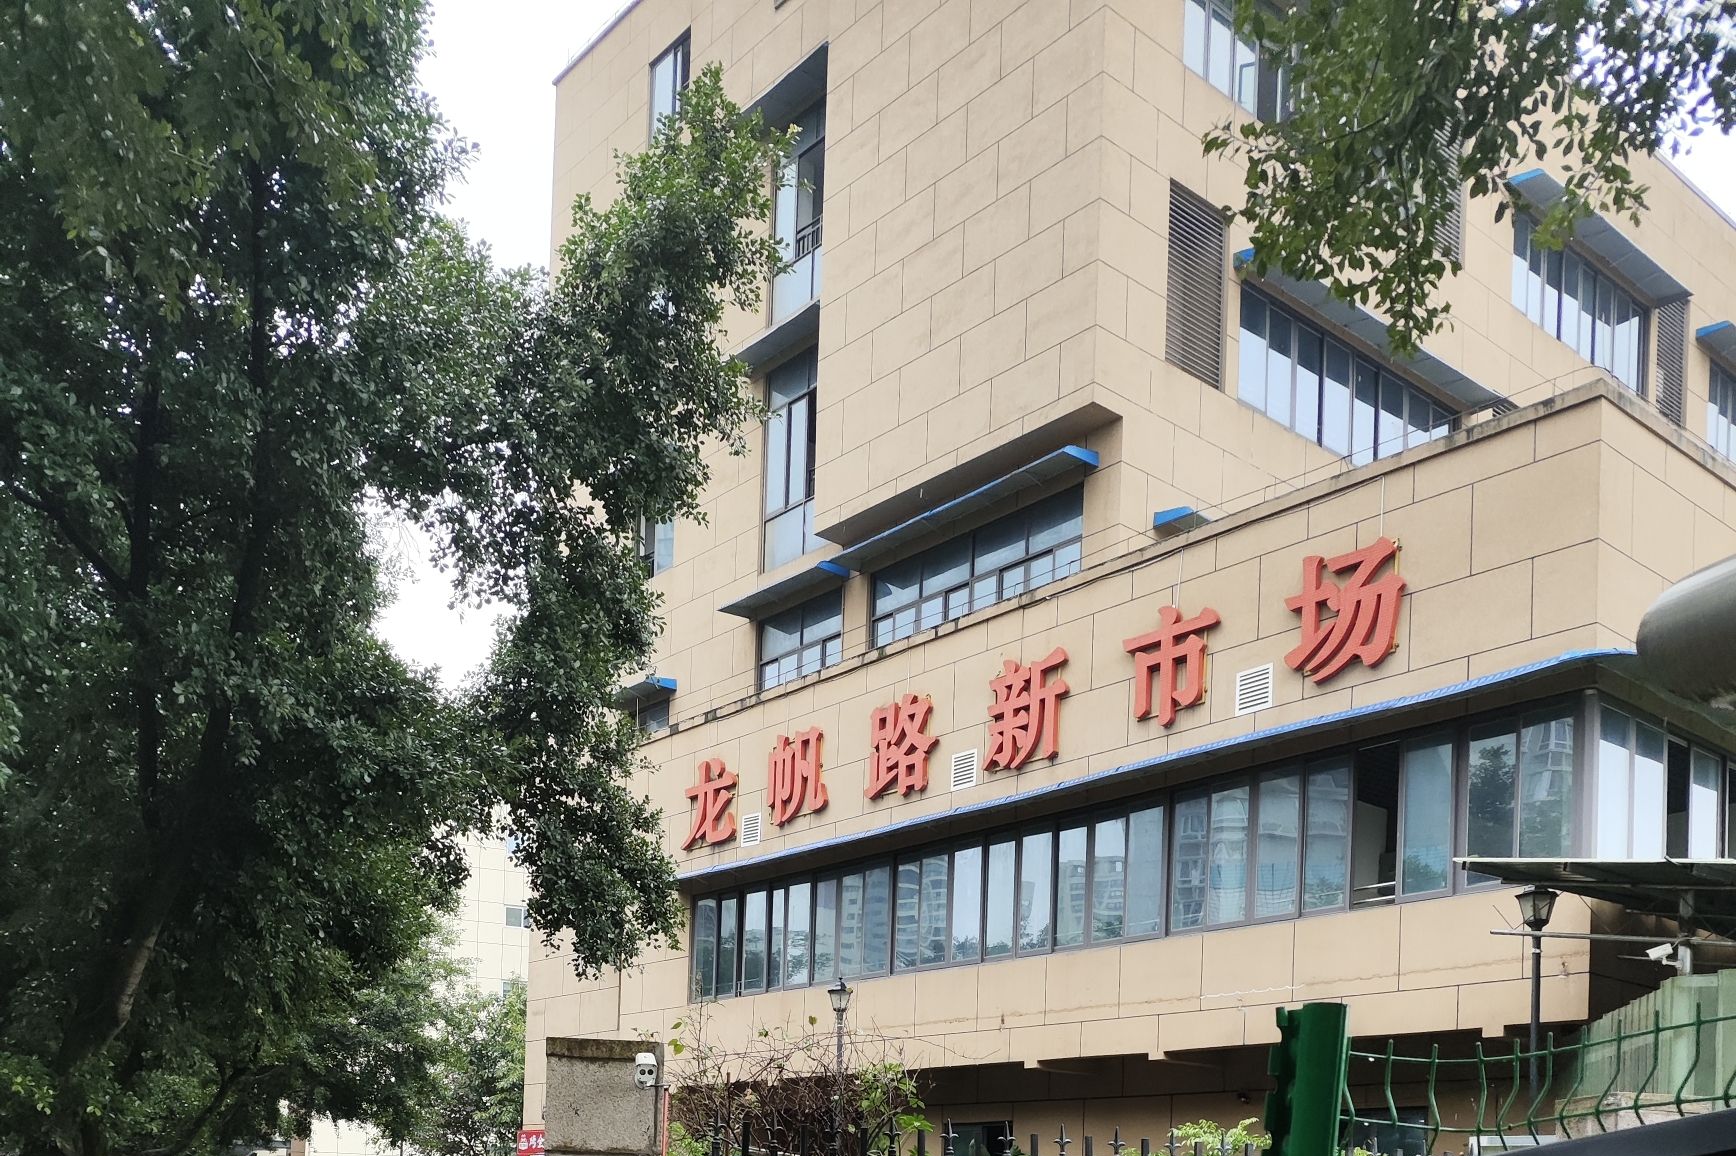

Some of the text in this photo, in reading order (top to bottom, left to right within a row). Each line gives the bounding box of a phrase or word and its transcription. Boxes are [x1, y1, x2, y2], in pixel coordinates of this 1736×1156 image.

[683, 537, 1406, 850] 龙帆路新市场
